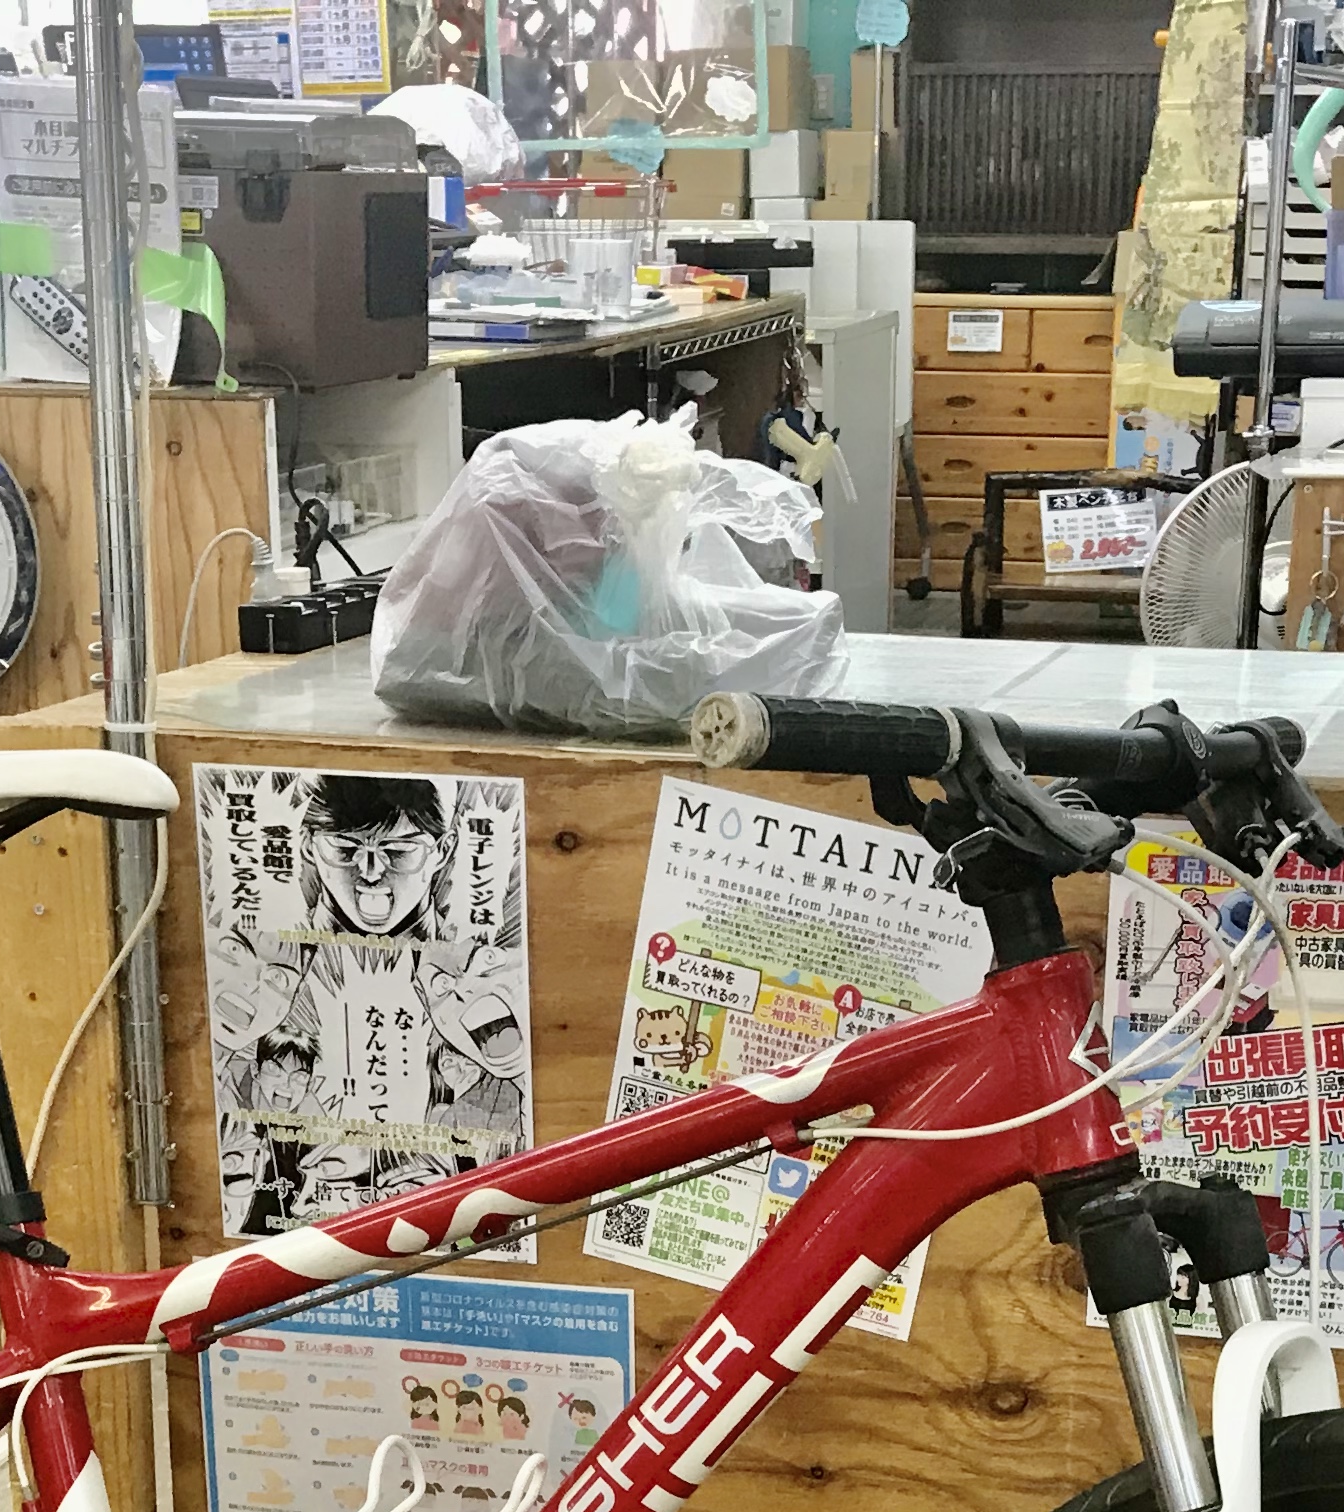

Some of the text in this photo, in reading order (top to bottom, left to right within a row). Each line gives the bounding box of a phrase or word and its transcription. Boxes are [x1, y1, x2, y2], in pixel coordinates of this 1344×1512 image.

[261, 823, 295, 884] 愛品館で
[467, 817, 497, 927] 電子レンジは
[670, 840, 978, 928] モッタイナイは、世界中のアイコトバ。
[666, 862, 973, 949] It is a message from Japan to the world.
[656, 970, 751, 1010] 買取ってくれるの？
[678, 957, 736, 985] どんな物を
[758, 1005, 831, 1032] ご相談下さい
[774, 993, 823, 1016] お気軽に
[363, 1005, 390, 1123] なんだって
